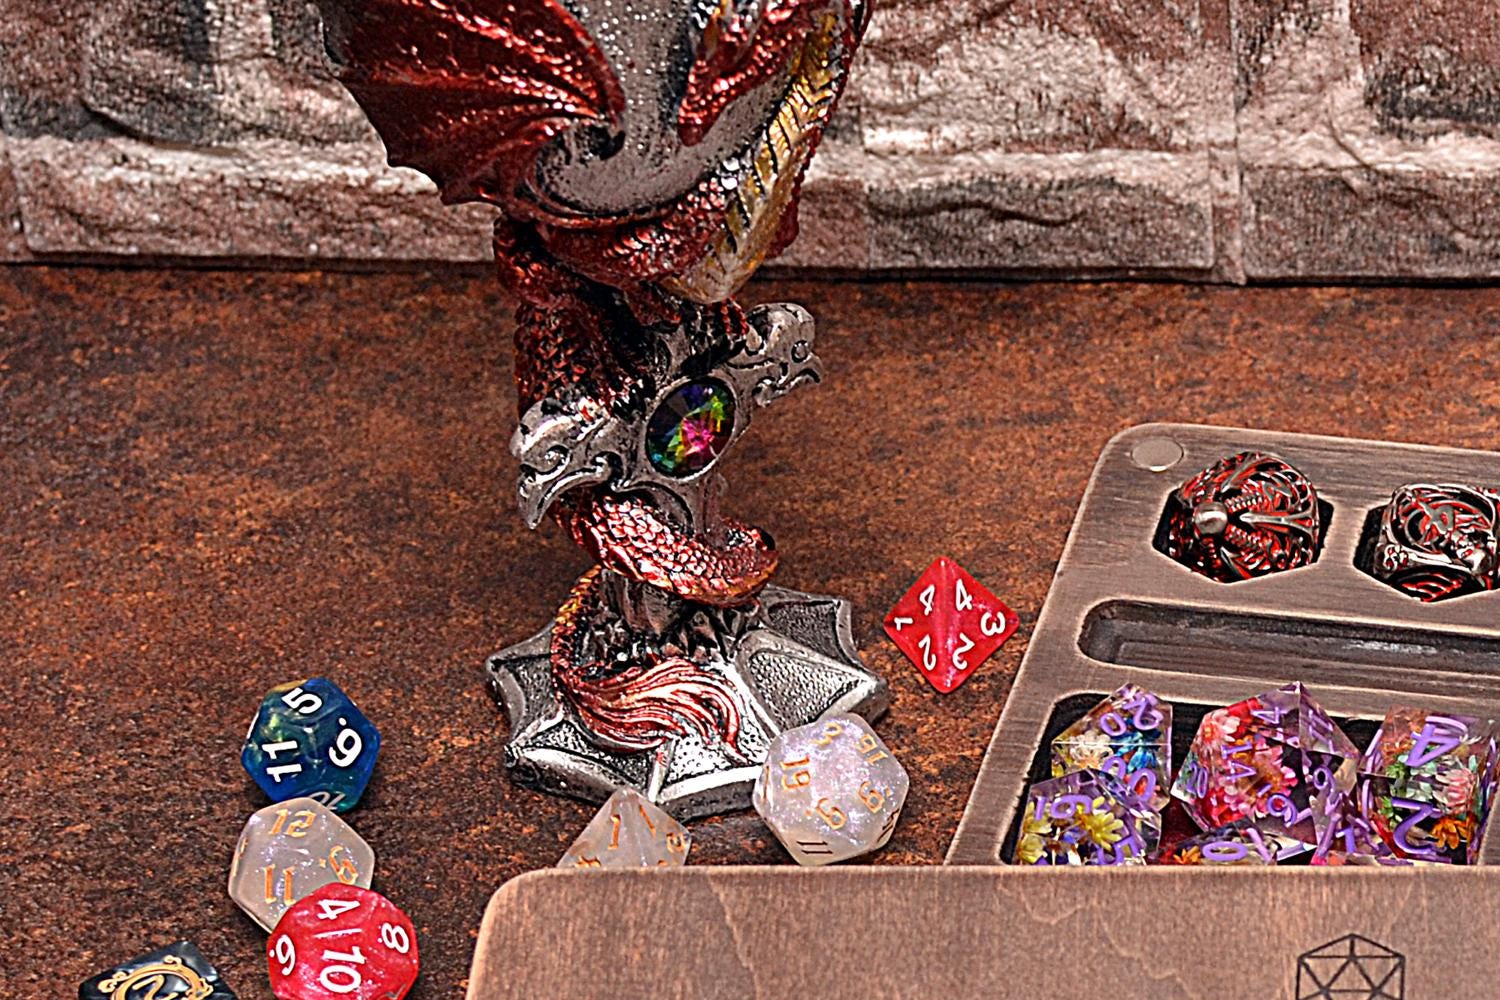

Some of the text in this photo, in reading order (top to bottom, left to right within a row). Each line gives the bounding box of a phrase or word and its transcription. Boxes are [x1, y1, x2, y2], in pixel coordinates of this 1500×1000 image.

[919, 584, 935, 616] 4
[955, 578, 973, 611] 4
[980, 611, 1006, 636] 3
[918, 633, 937, 671] 2
[952, 632, 975, 670] 2
[281, 687, 323, 714] 5
[261, 740, 302, 783] 11
[1221, 740, 1257, 783] 14
[1404, 723, 1462, 768] 4
[779, 754, 811, 792] 19
[1187, 760, 1209, 799] 20
[268, 809, 317, 838] 12
[607, 814, 621, 850] 1
[263, 863, 297, 906] 11
[317, 899, 361, 921] 4
[381, 922, 410, 954] 8
[319, 946, 367, 994] 10
